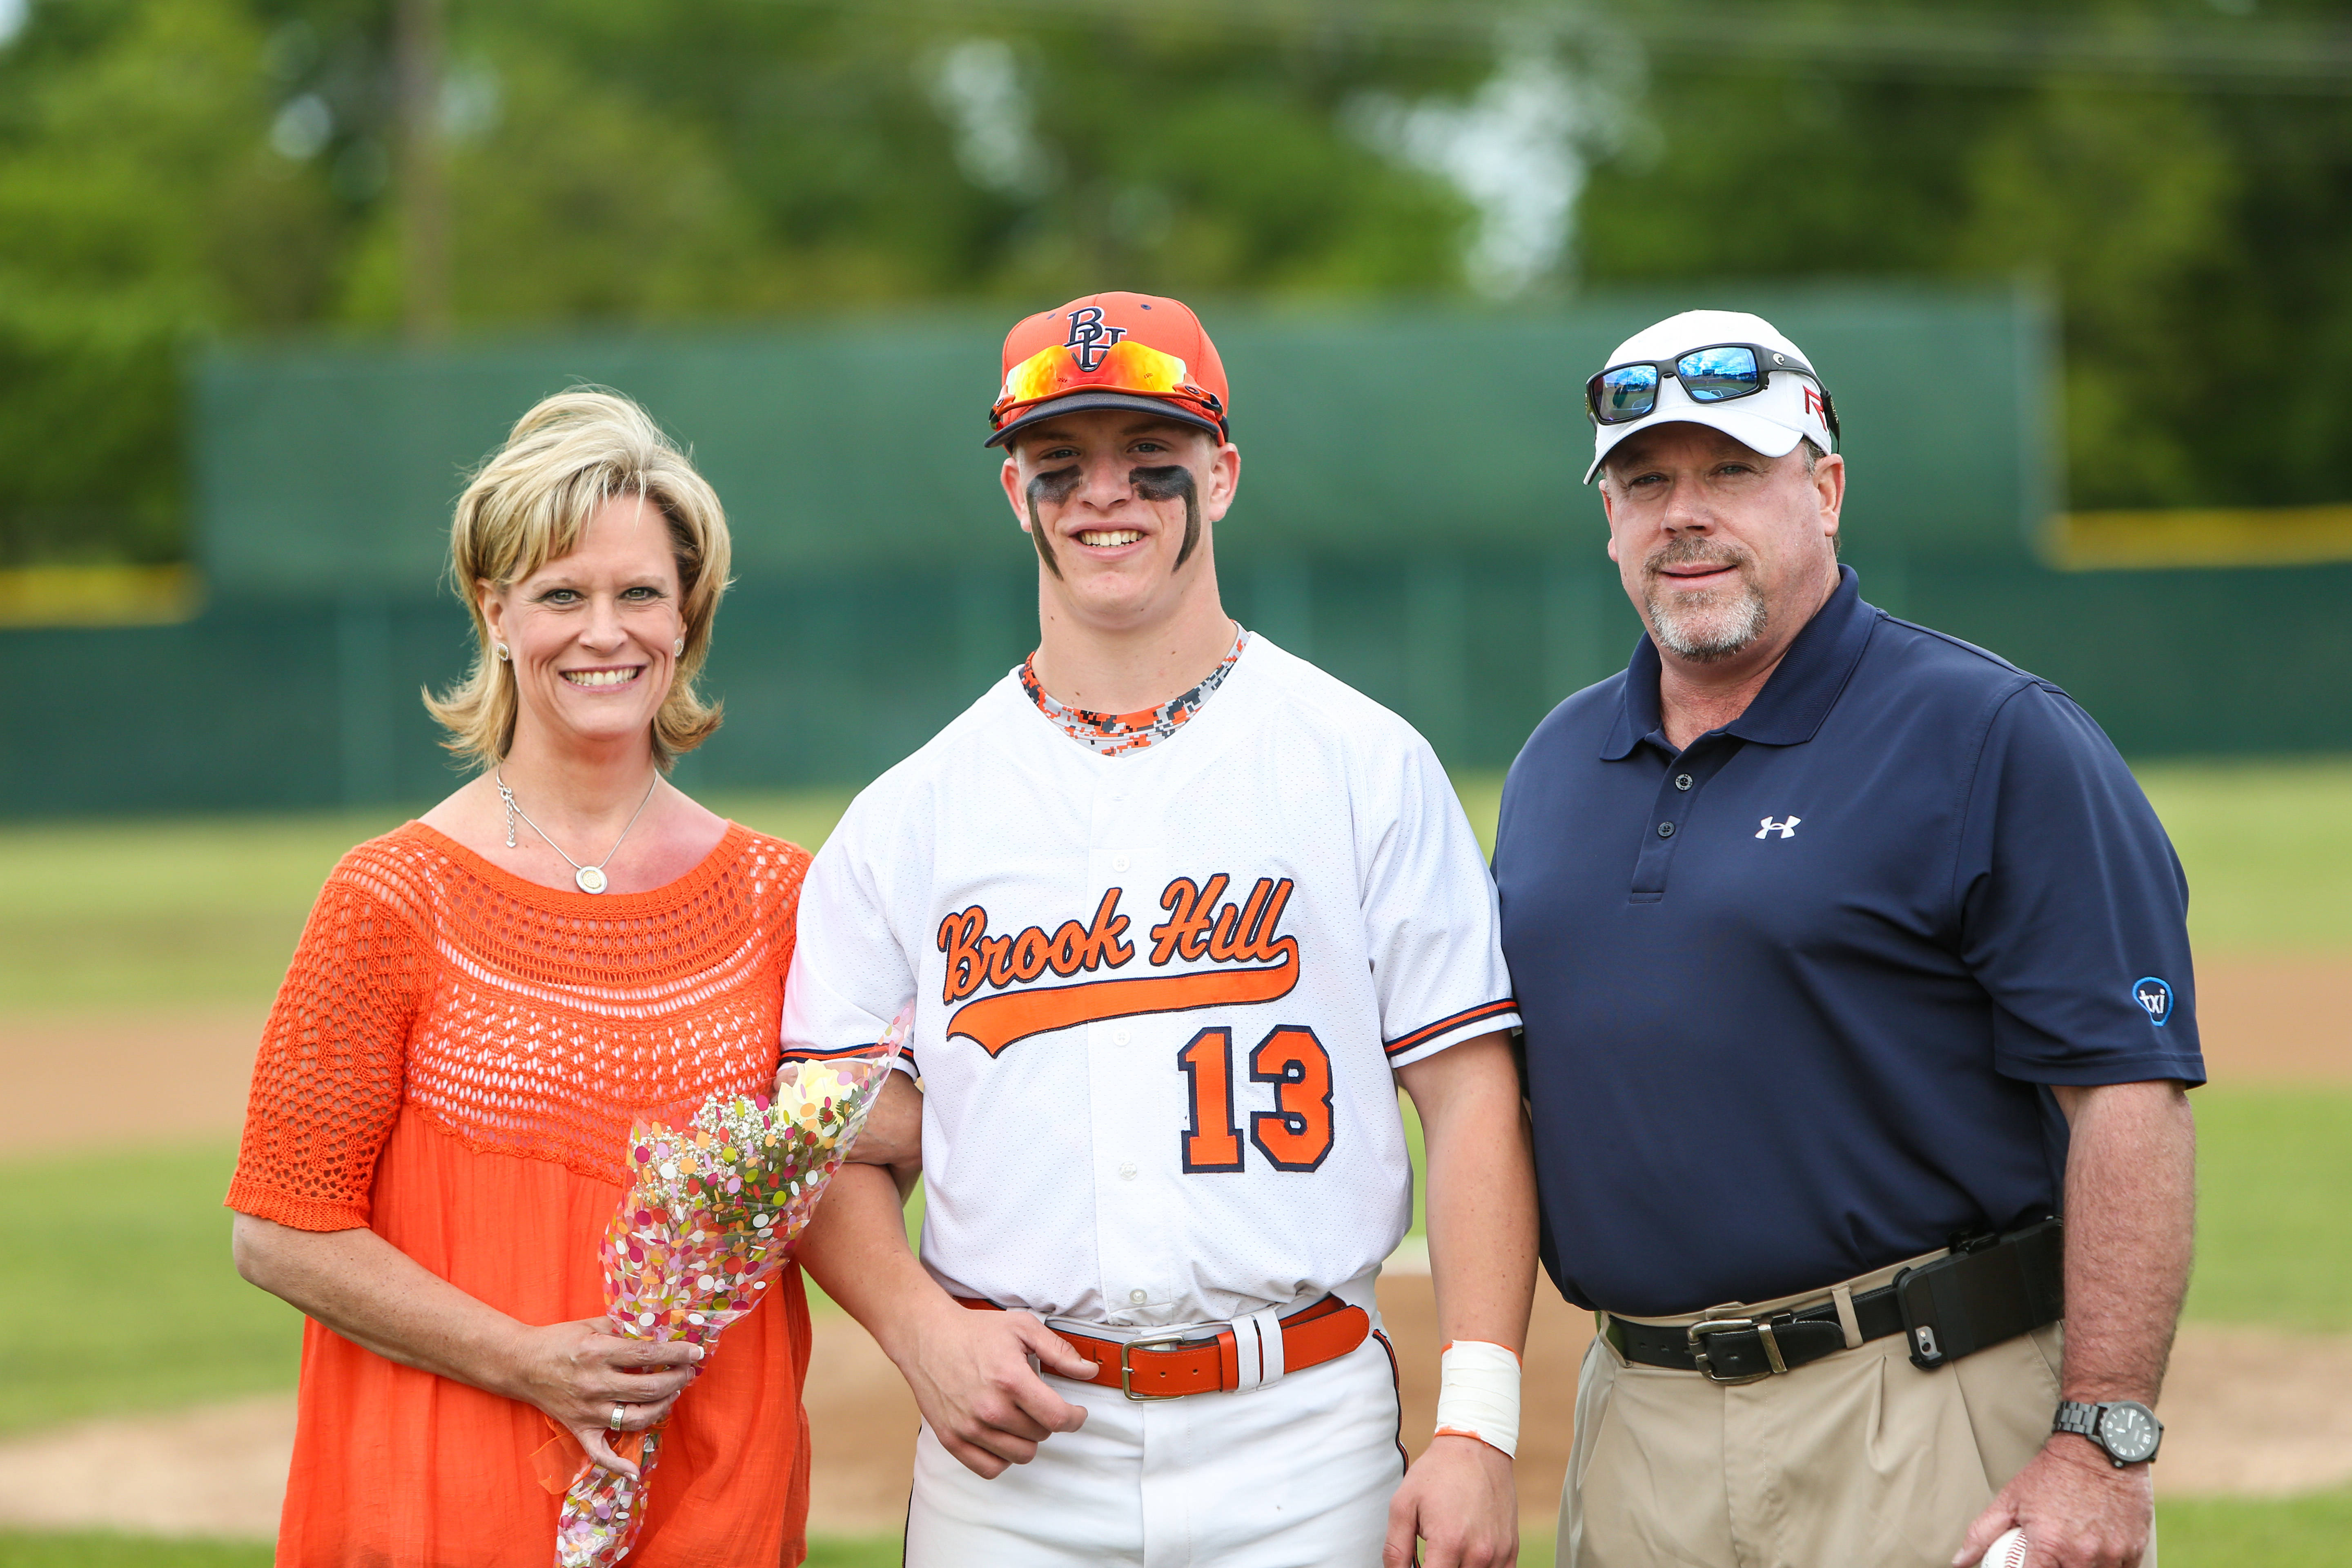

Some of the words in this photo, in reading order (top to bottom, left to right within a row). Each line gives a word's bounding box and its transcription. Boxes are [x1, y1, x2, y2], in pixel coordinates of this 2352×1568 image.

[937, 887, 1134, 1005] Brook
[1149, 873, 1296, 966] Hill
[2139, 989, 2165, 1014] txi
[1177, 1025, 1334, 1173] 13
[2143, 1434, 2151, 1444] 12
